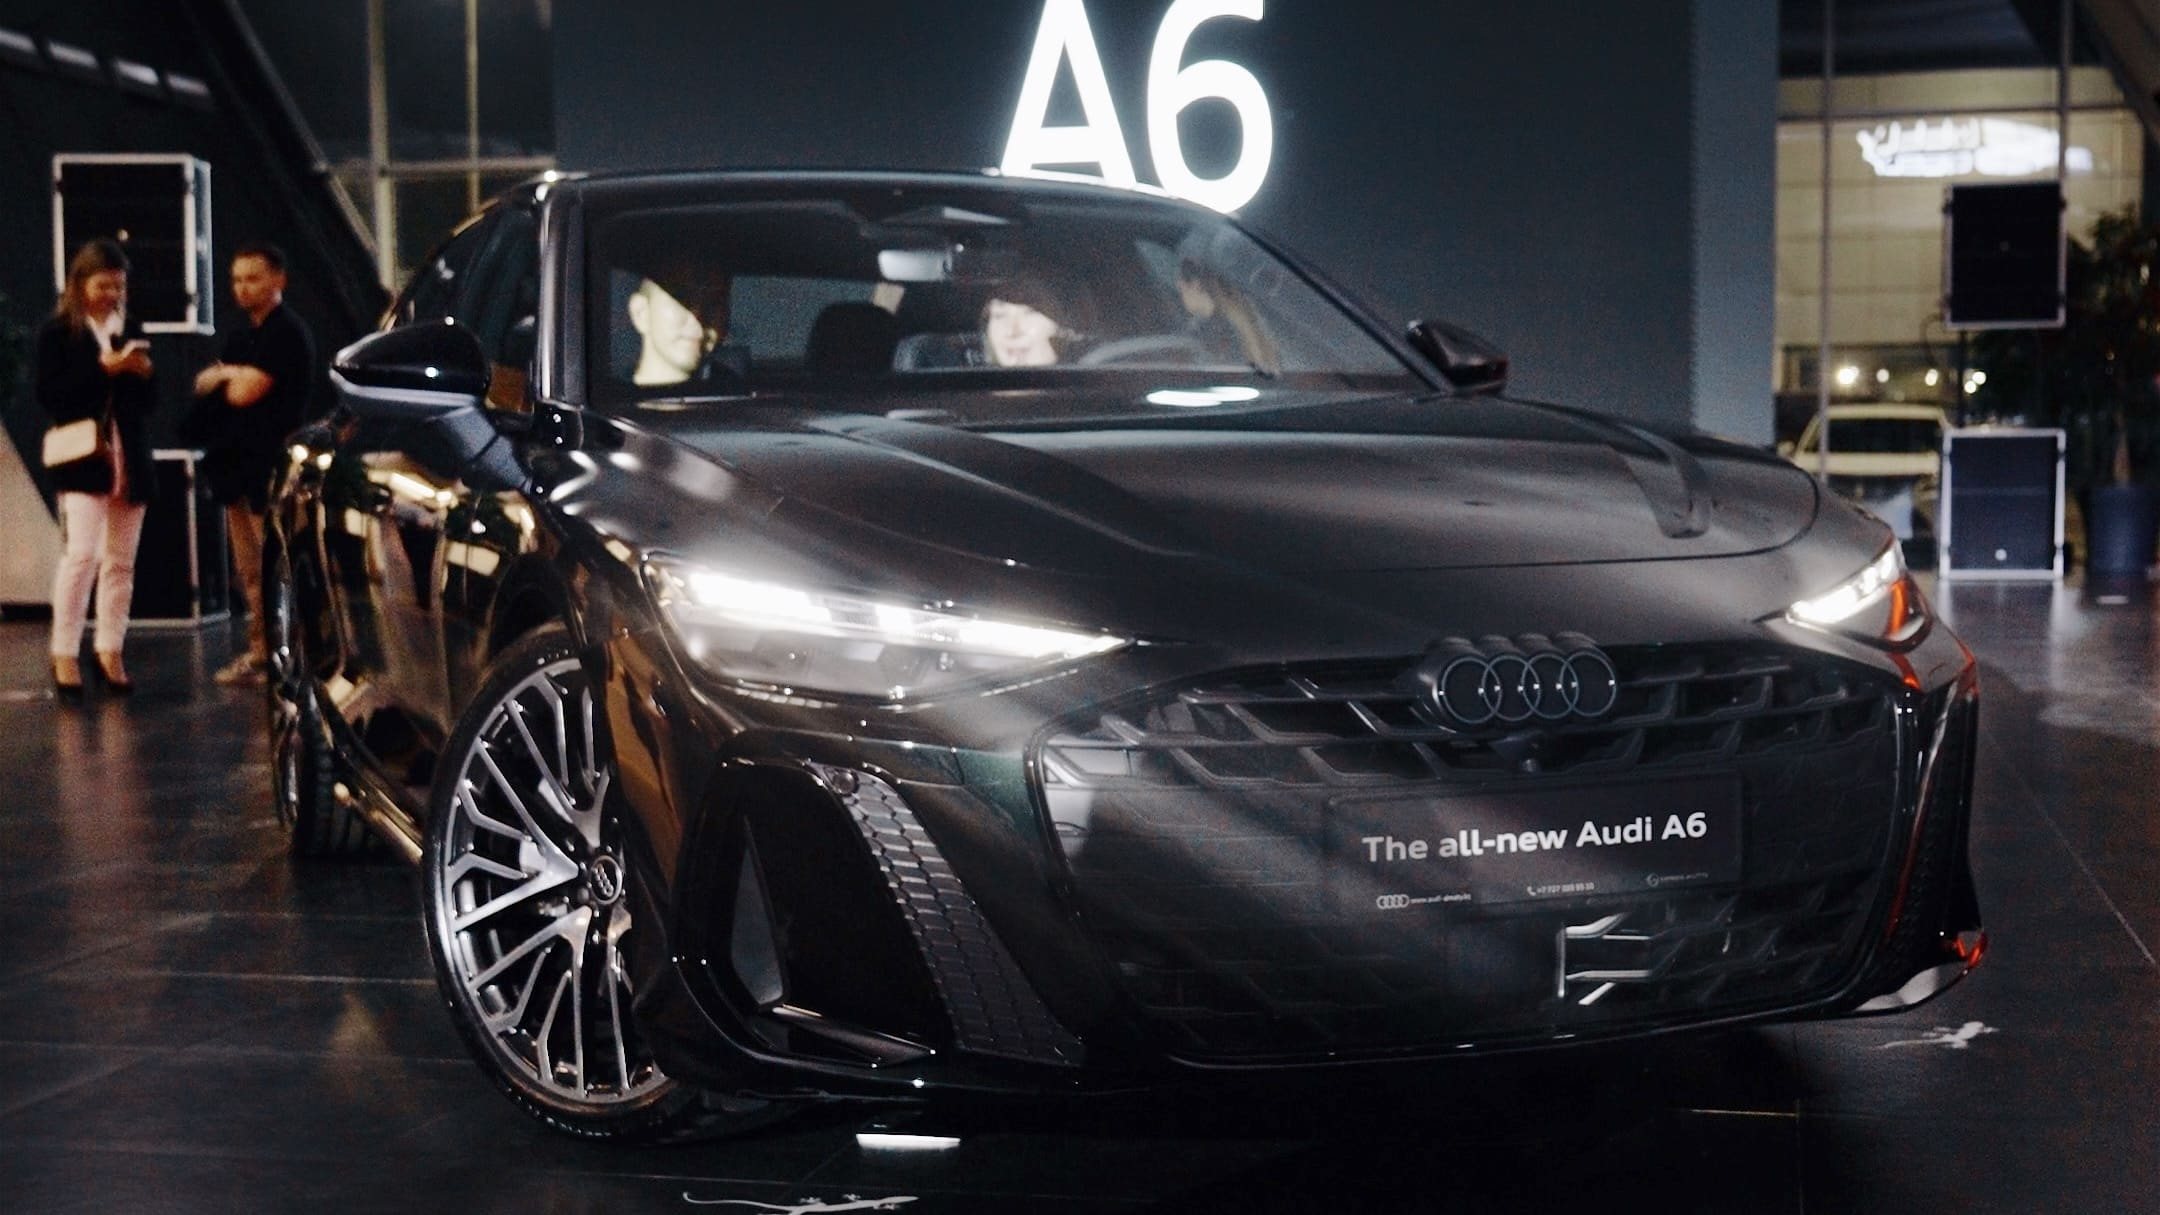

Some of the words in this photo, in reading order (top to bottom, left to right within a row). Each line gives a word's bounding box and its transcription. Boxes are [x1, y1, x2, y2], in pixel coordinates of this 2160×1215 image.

[1000, 0, 1273, 214] A6
[1361, 836, 1429, 862] The
[1439, 829, 1568, 858] all-new
[1576, 817, 1653, 848] Audi
[1661, 812, 1708, 840] A6
